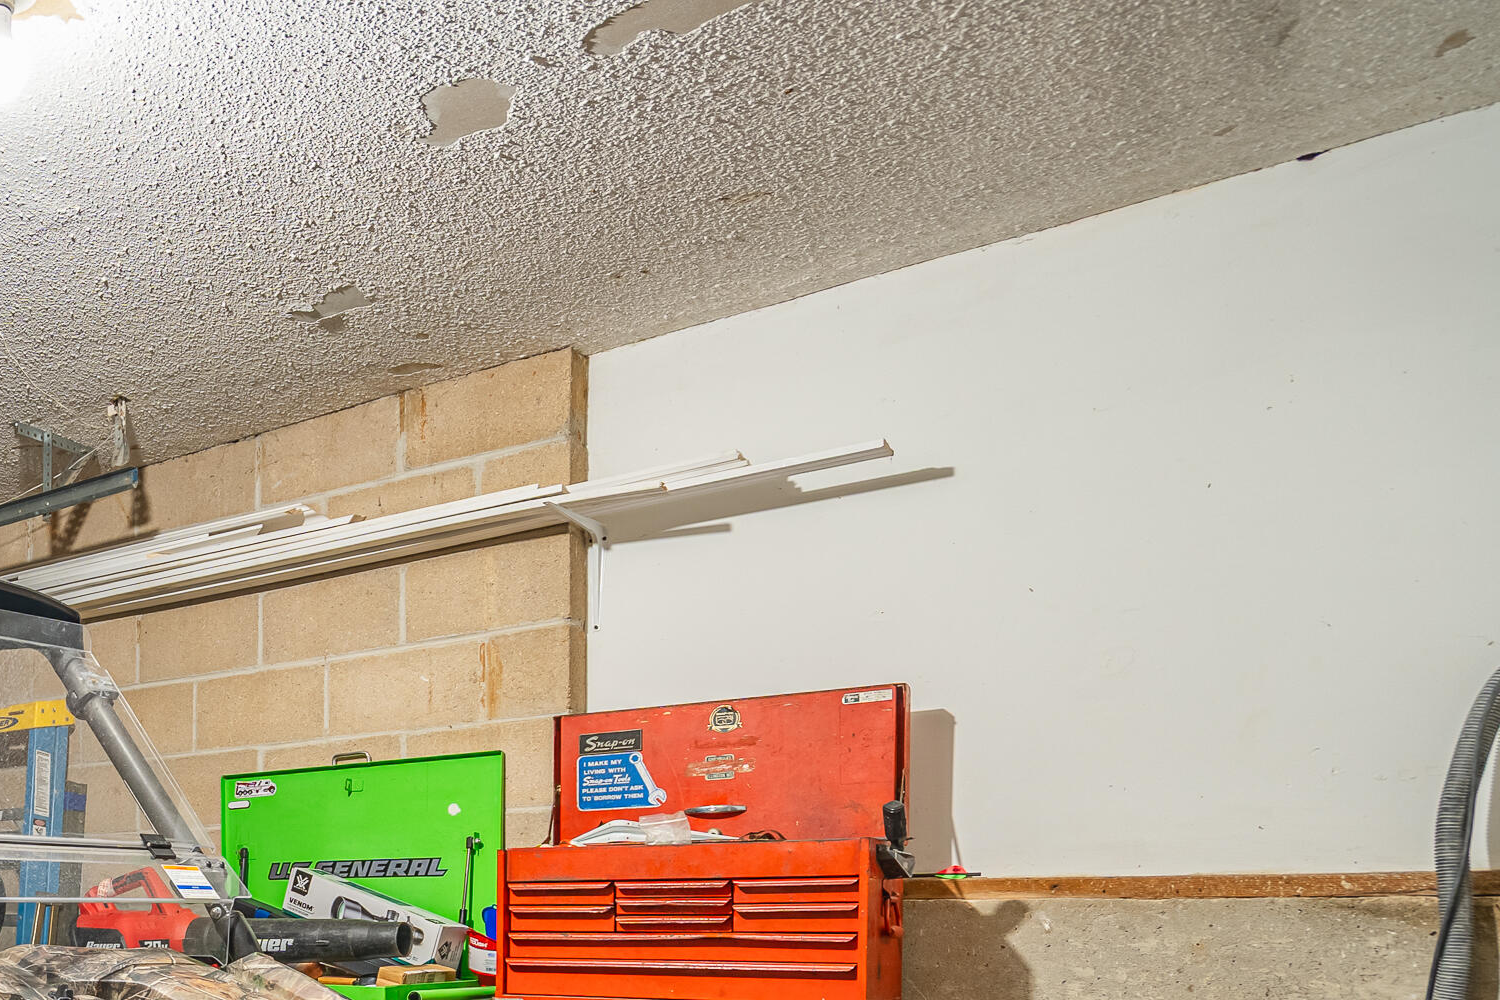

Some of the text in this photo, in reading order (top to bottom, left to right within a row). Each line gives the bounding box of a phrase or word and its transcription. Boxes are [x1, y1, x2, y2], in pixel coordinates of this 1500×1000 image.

[584, 736, 636, 752] Snap-on
[582, 774, 630, 786] Snap-on Tools
[316, 858, 448, 878] GENERAL
[290, 897, 313, 911] VENOM
[257, 939, 294, 952] uer
